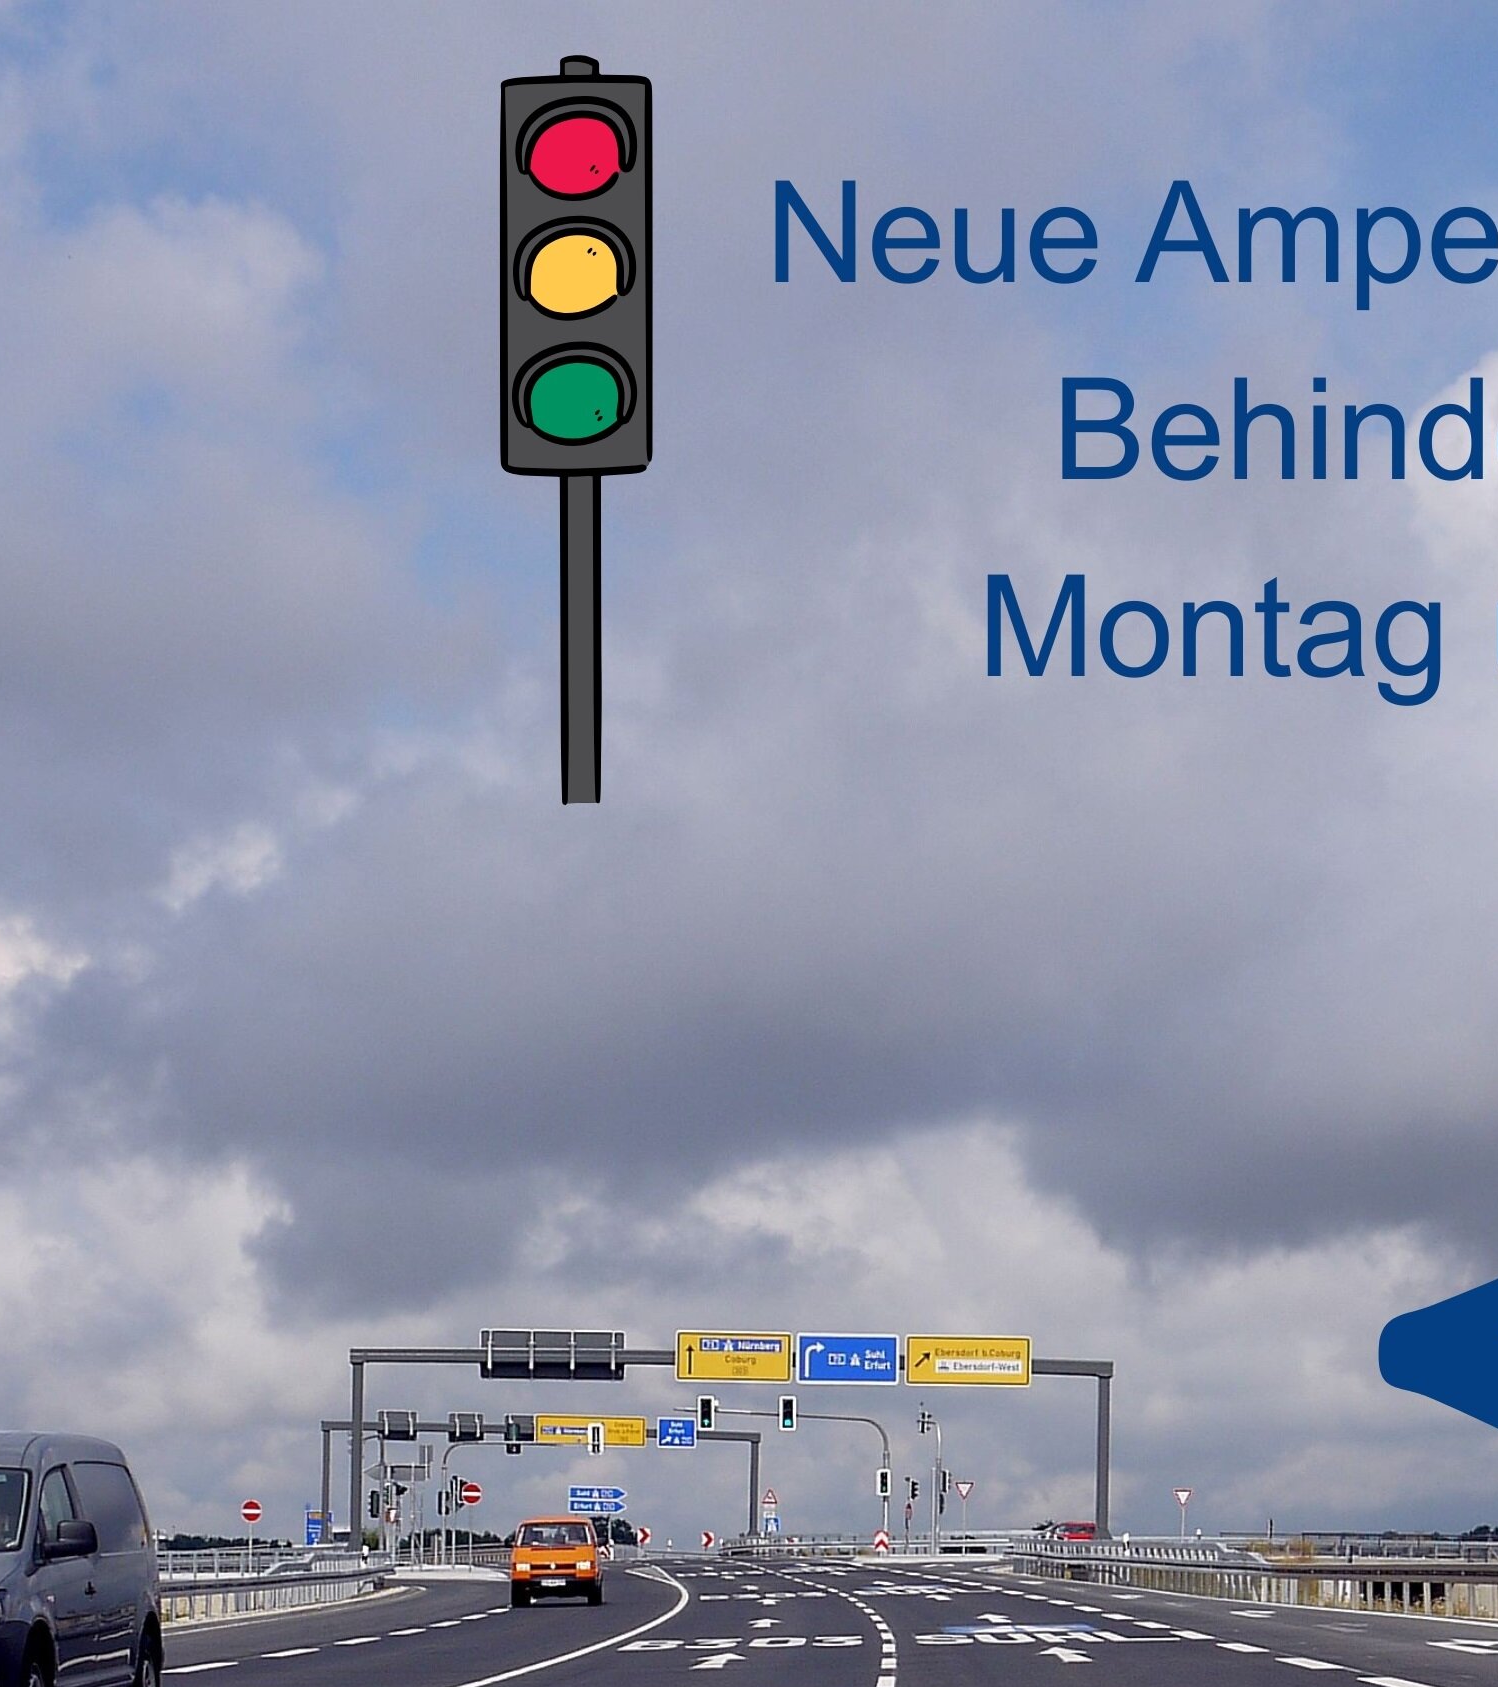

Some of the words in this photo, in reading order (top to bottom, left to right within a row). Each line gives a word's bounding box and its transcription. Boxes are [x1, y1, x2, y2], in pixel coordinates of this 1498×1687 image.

[738, 1340, 780, 1352] Nürnberg
[865, 1349, 886, 1359] Suhl
[935, 1347, 979, 1357] Ebersdorf
[724, 1354, 757, 1366] Coburg
[864, 1360, 891, 1370] Erfurt
[953, 1361, 1020, 1371] Ebersdorf-West
[617, 1636, 863, 1651] B303
[916, 1632, 1181, 1646] SUHL
